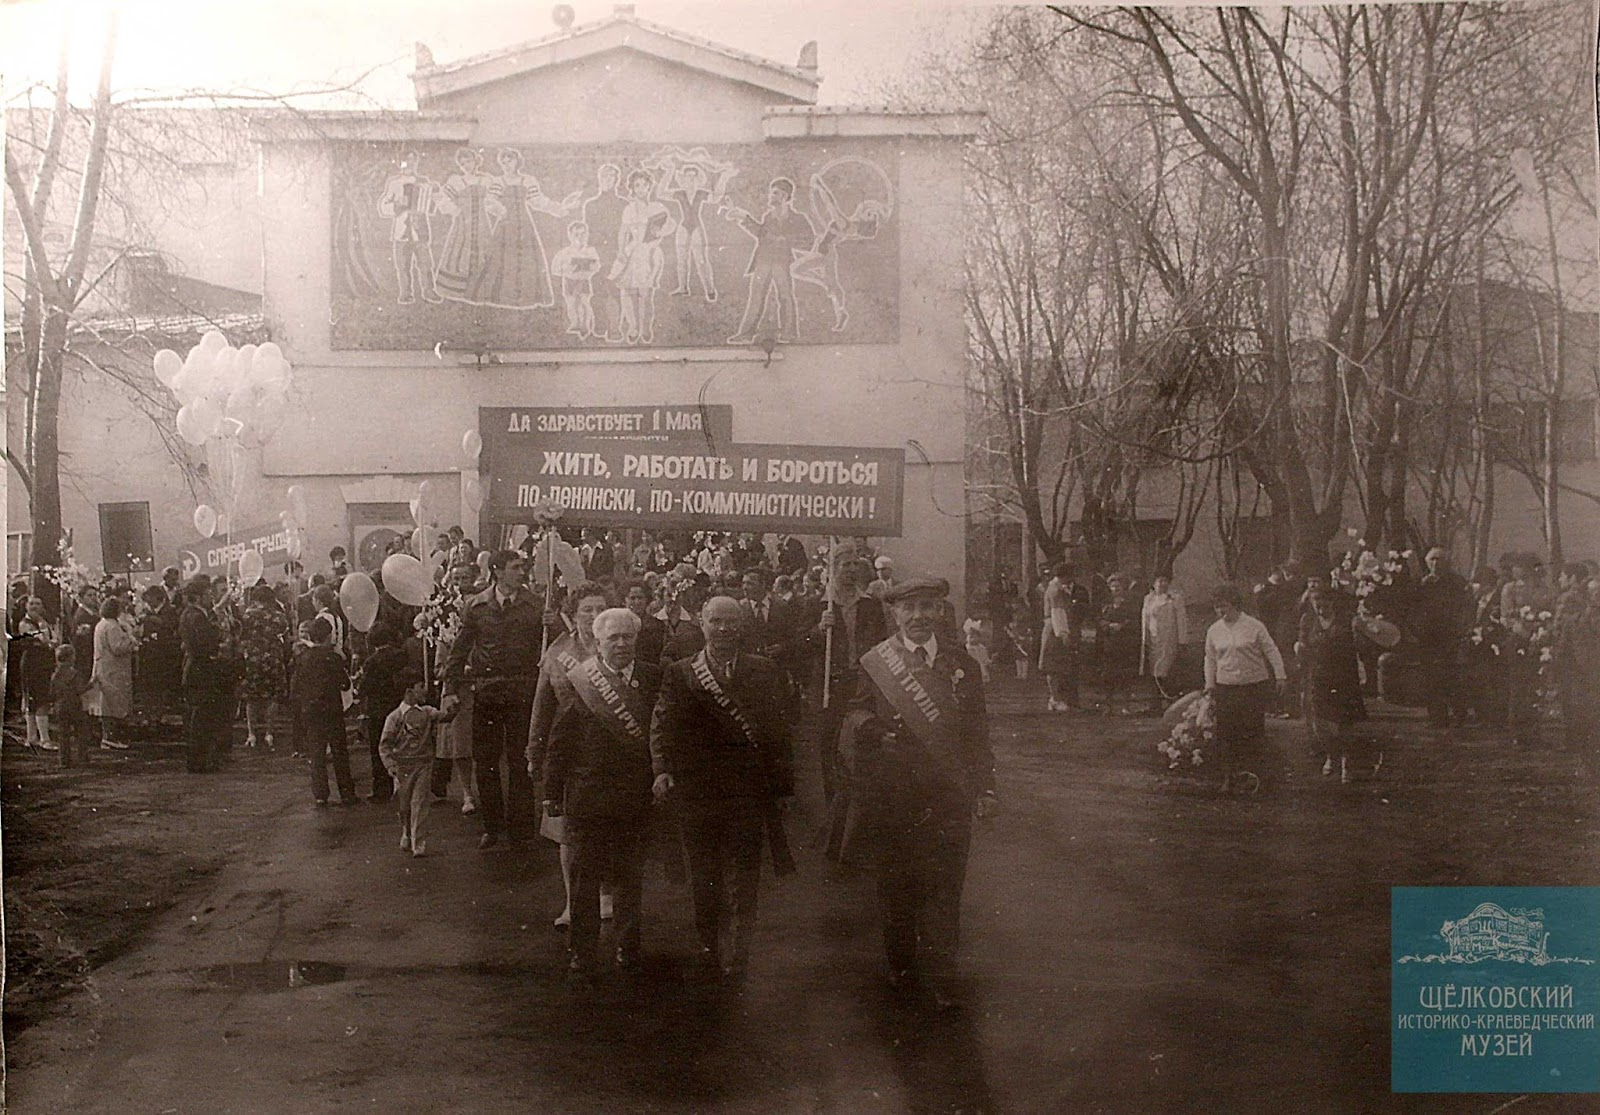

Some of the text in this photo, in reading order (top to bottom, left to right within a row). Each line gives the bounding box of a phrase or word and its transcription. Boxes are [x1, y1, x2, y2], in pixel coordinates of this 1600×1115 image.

[507, 409, 702, 432] ДА ЗДРАВСТВУЕТ 1 МАЯ
[540, 451, 878, 486] ЖИТЬ, РАБОТАТЬ И БОРОТЬСЯ
[900, 672, 940, 722] ТРУДА
